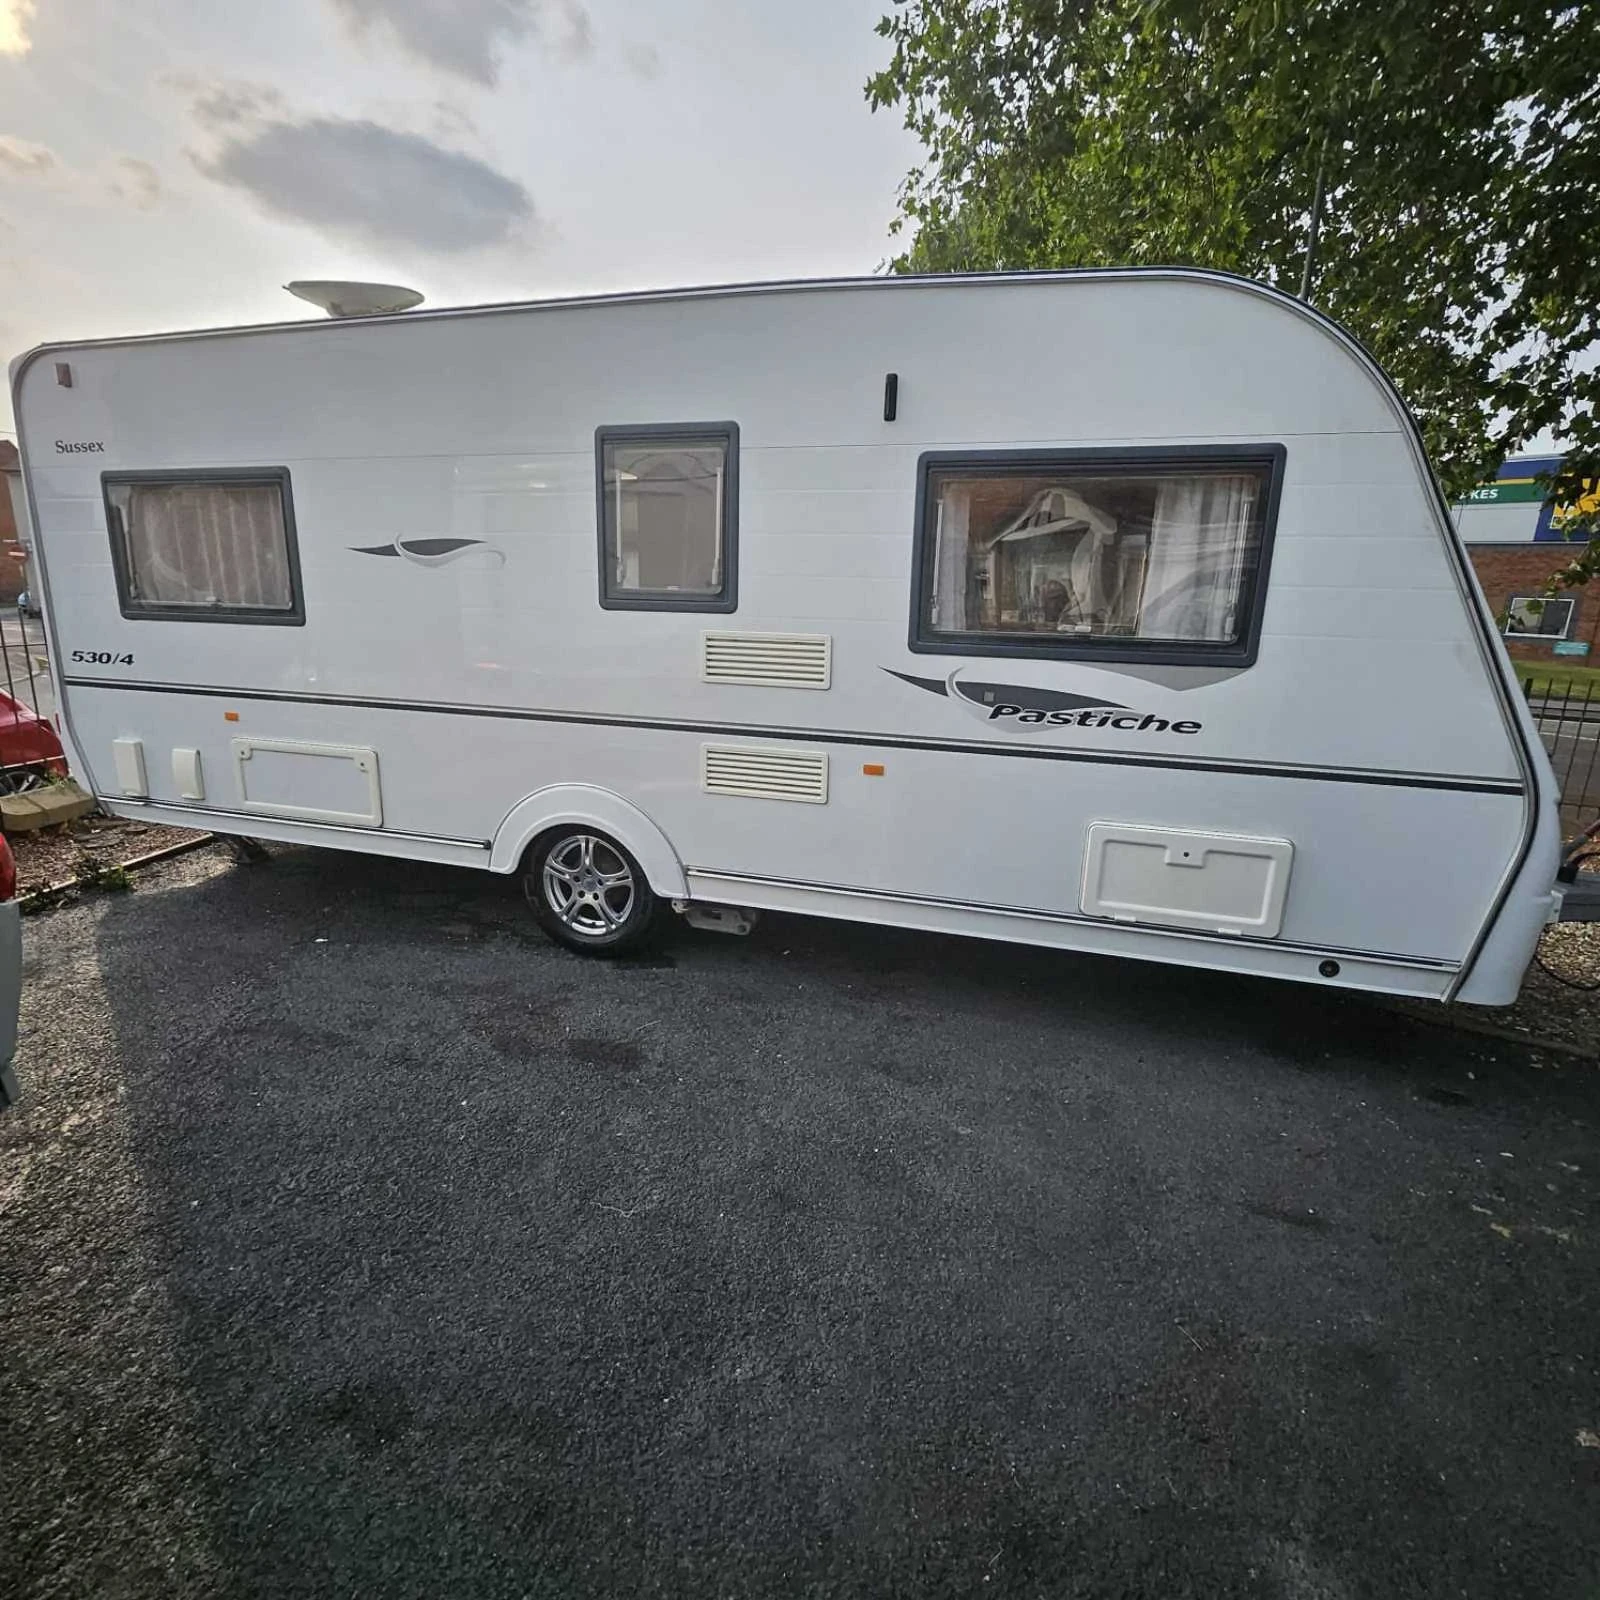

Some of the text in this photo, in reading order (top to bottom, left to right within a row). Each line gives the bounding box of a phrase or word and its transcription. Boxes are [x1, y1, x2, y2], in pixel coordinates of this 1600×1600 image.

[55, 440, 105, 454] Sussex
[71, 650, 135, 665] 530/4
[989, 704, 1203, 735] Pastiche
